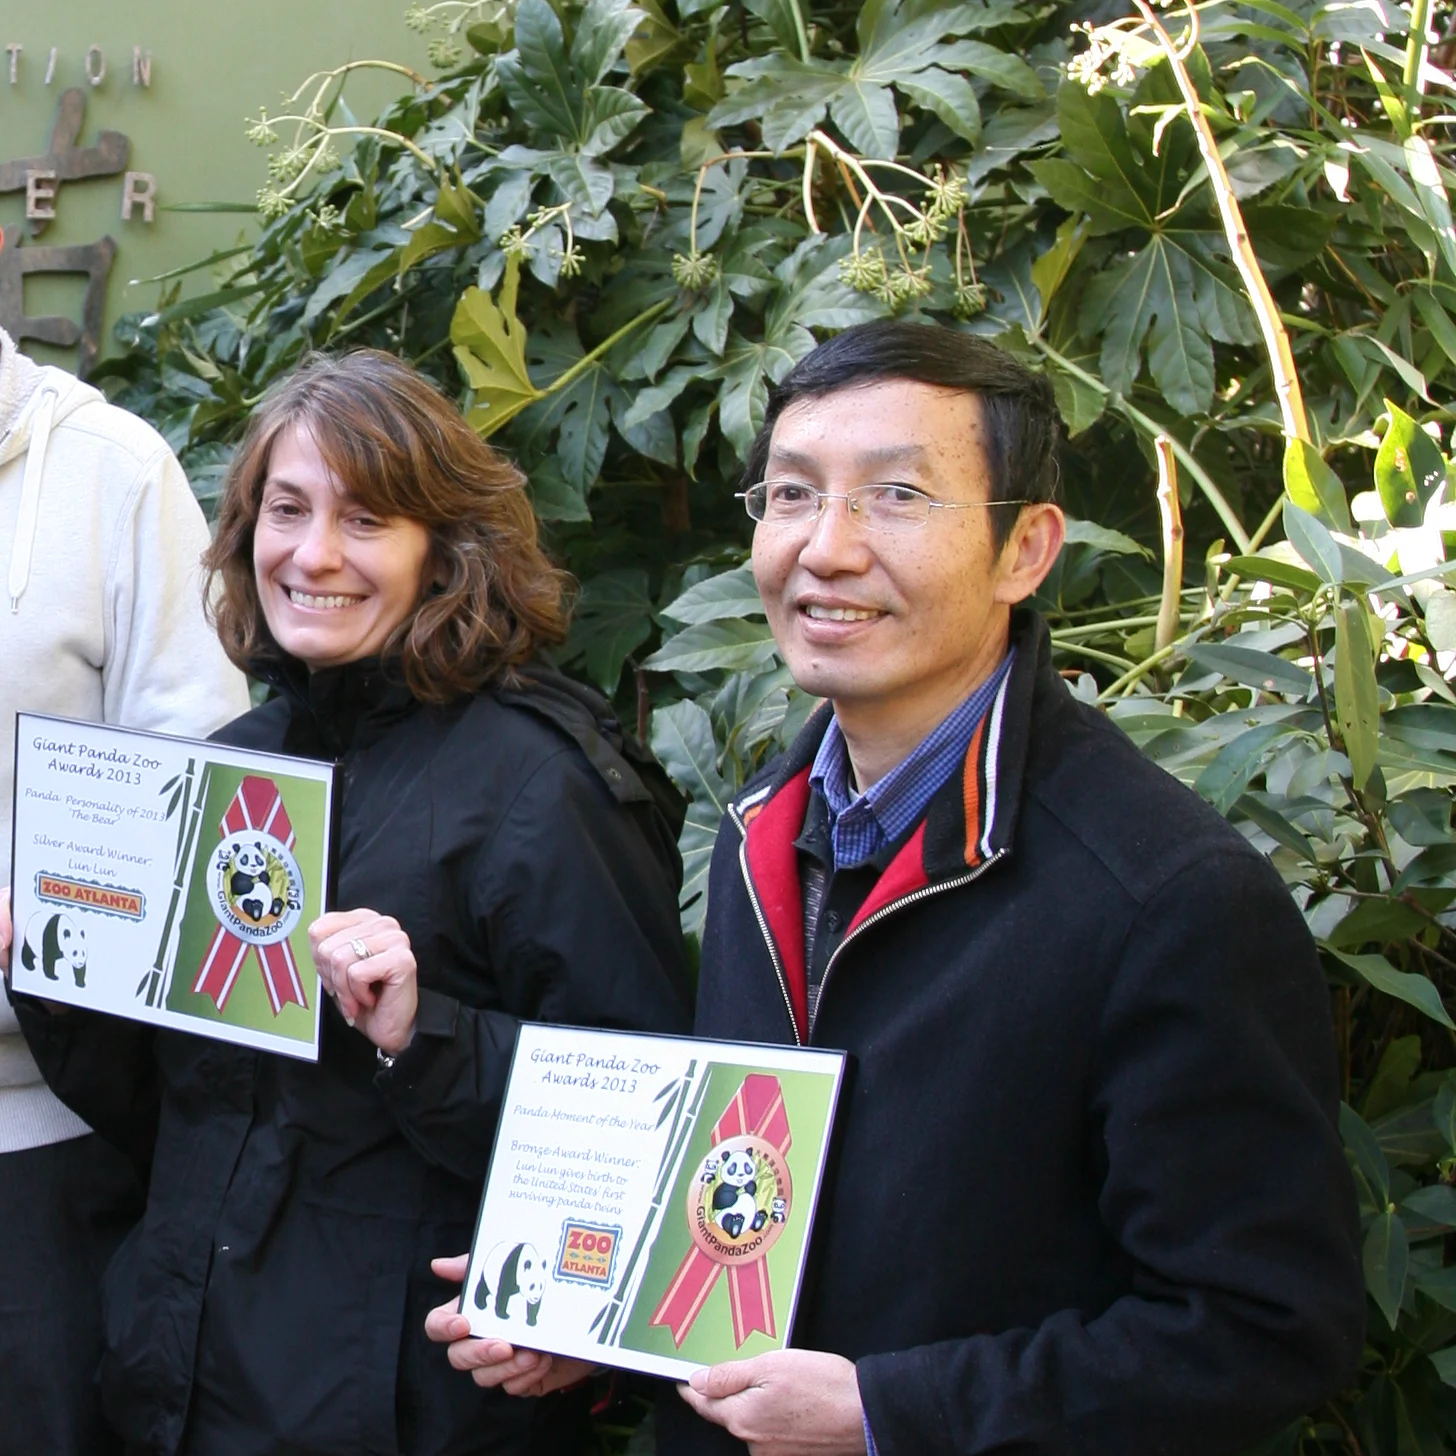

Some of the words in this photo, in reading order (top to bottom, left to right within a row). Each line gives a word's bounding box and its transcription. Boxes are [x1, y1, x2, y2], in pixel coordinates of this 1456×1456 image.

[33, 737, 76, 755] Giant
[79, 745, 131, 764] Panda
[132, 753, 162, 770] Zoo
[48, 757, 104, 779] Awards
[106, 767, 141, 785] 2013
[25, 787, 62, 802] Panda
[66, 795, 125, 815] Personality
[126, 806, 140, 819] of
[140, 808, 166, 822] 2013
[33, 833, 65, 848] Silver
[66, 841, 106, 857] Award
[68, 858, 92, 872] Lun
[93, 863, 118, 878] Lun
[43, 881, 71, 897] ZOO
[74, 888, 139, 912] ATLANTA
[531, 1048, 575, 1065] Giant
[576, 1053, 630, 1071] Panda
[631, 1059, 662, 1075] Zoo
[542, 1070, 599, 1089] Awards
[600, 1076, 637, 1093] 2013
[513, 1104, 551, 1118] Panda
[551, 1108, 596, 1124] Moment
[596, 1114, 609, 1128] of
[608, 1114, 627, 1128] the
[629, 1118, 656, 1131] Year
[510, 1140, 552, 1159] Bronze
[552, 1146, 593, 1161] Award
[516, 1160, 538, 1171] Lun
[538, 1162, 560, 1175] Lun
[560, 1167, 586, 1181] gives
[587, 1169, 615, 1183] birth
[616, 1175, 628, 1185] to
[513, 1173, 530, 1185] the
[530, 1177, 567, 1191] United
[602, 1186, 626, 1200] first
[508, 1189, 556, 1208] surviving
[556, 1196, 594, 1209] panda
[594, 1202, 623, 1216] twins
[567, 1230, 612, 1255] ZOO
[562, 1260, 607, 1278] ATLANTA
